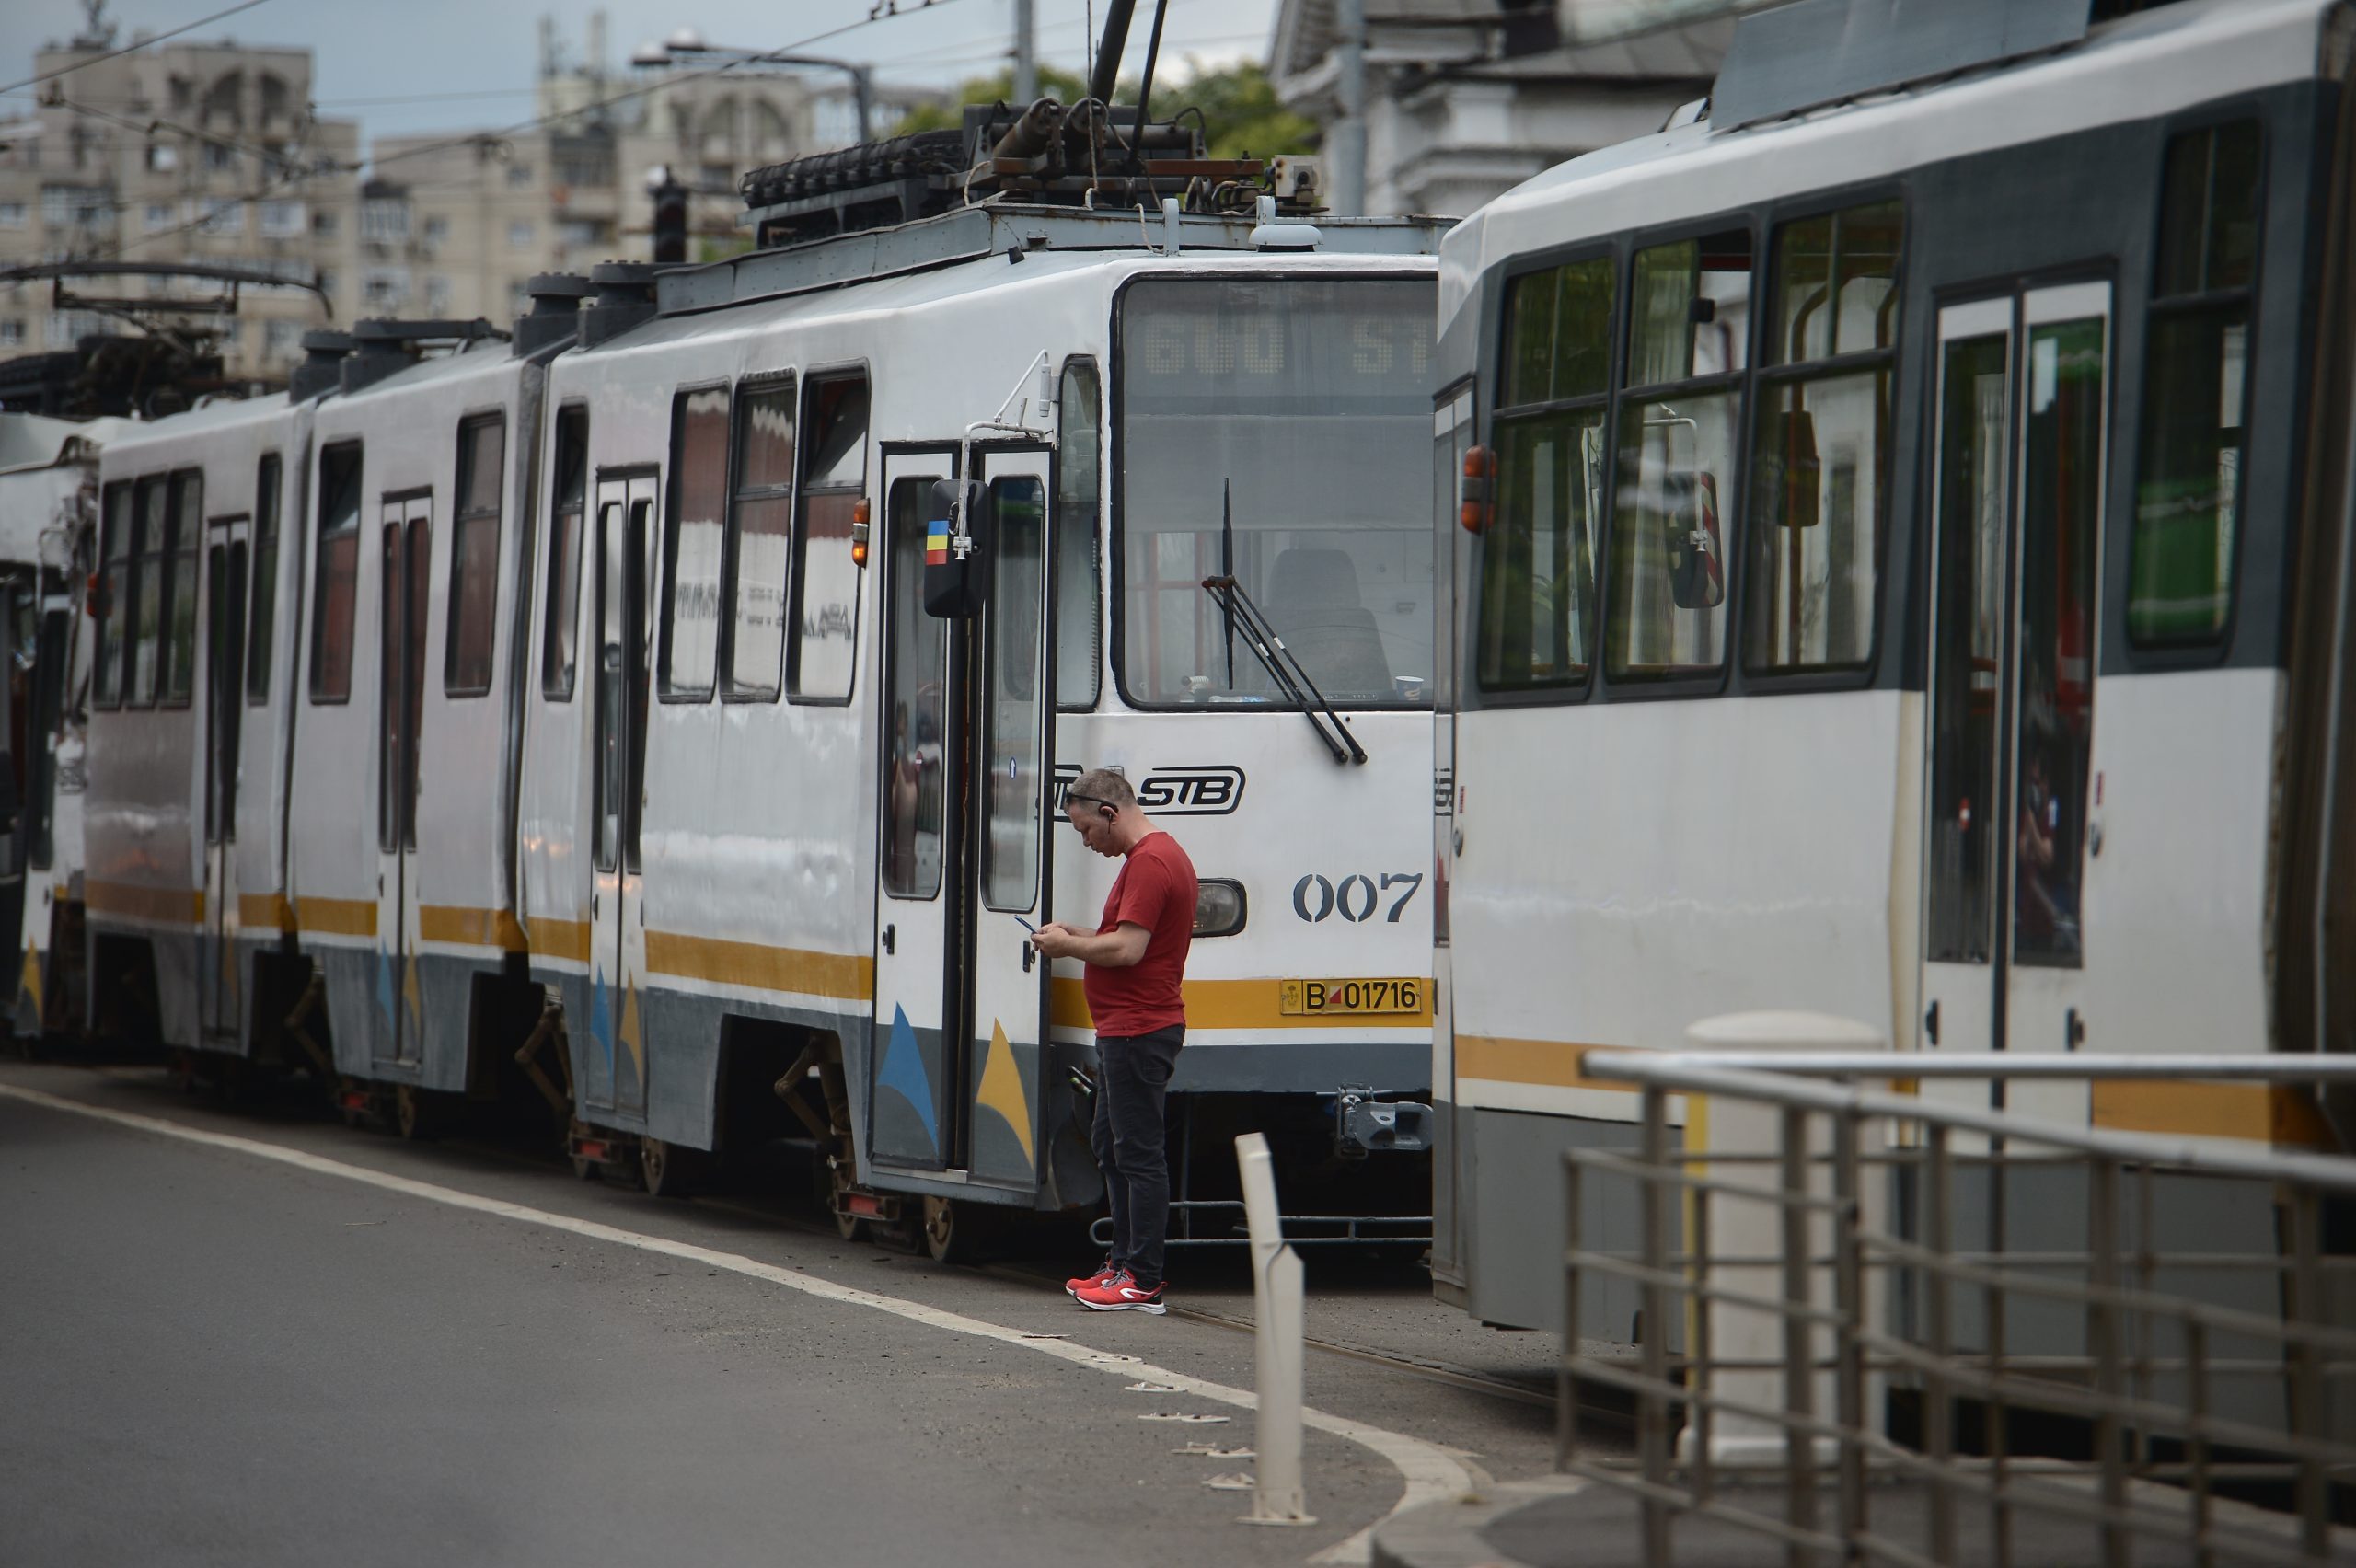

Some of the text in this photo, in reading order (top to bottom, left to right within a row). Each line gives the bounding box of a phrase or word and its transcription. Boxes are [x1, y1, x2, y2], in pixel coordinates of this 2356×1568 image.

[1136, 774, 1236, 807] STB
[1292, 872, 1424, 923] 007
[1306, 981, 1416, 1009] B 01716
